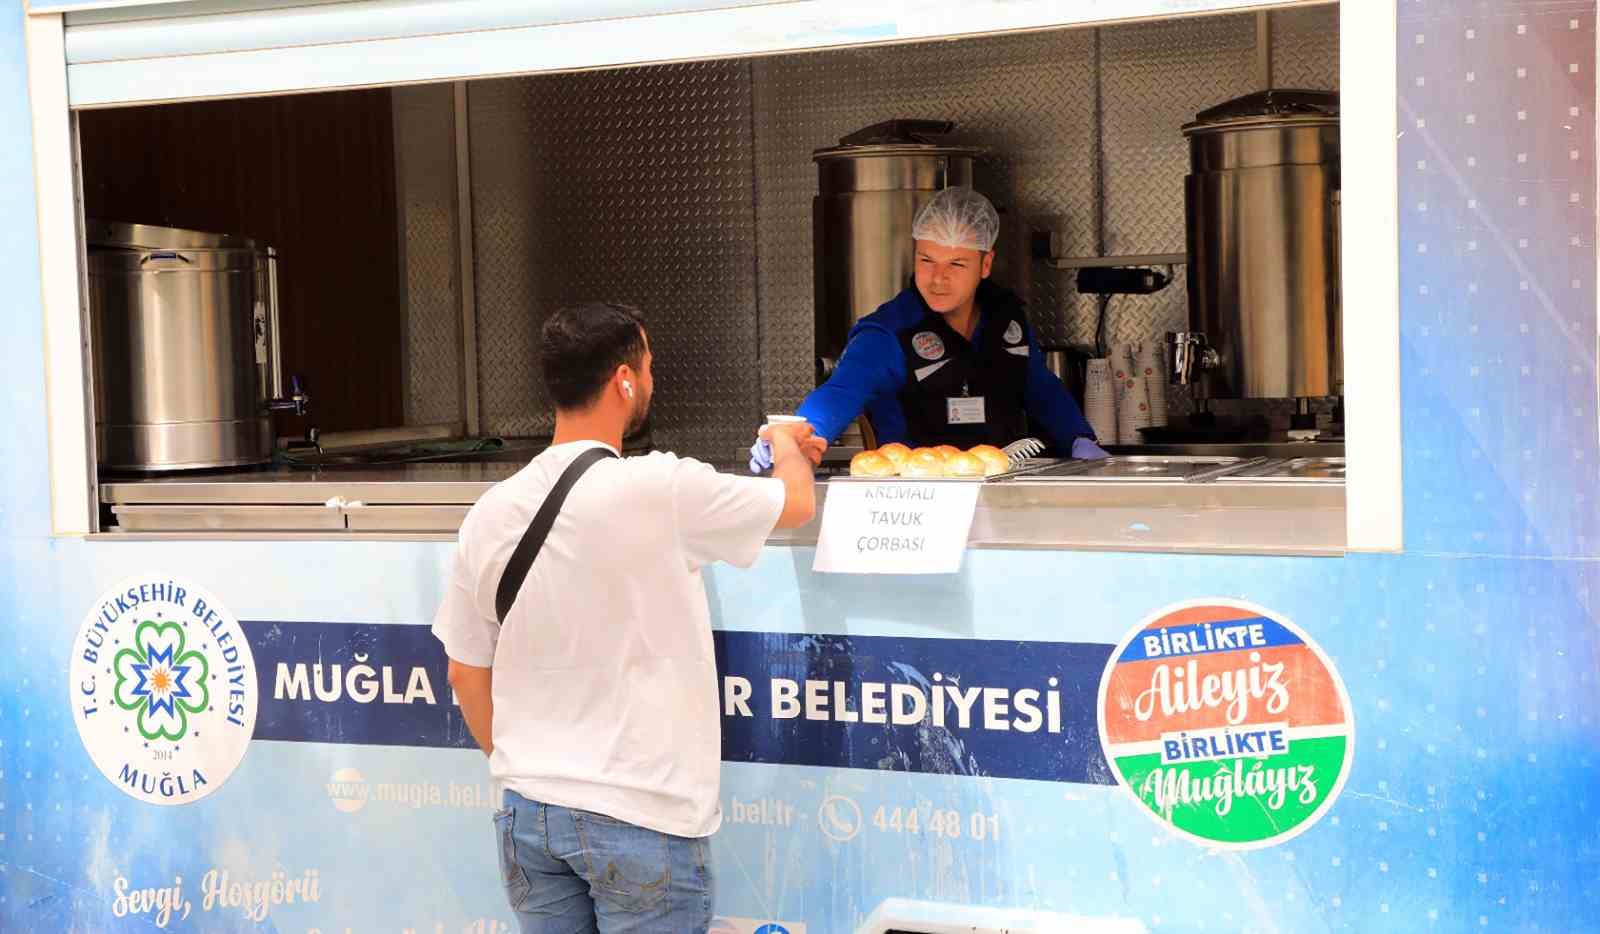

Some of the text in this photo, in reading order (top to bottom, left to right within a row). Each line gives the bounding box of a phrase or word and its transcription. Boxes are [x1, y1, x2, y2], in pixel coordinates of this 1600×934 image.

[869, 510, 925, 526] TAVUK
[856, 535, 926, 553] ÇORBASI
[81, 580, 246, 727] T.C. BÜYÜKŞEHİR BELEDİYESİ
[1143, 623, 1267, 657] BİRLİKTE
[274, 652, 437, 705] MUĞLA
[1134, 652, 1291, 725] Aileyiz
[770, 672, 1062, 733] BELEDİYESİ
[152, 750, 173, 761] 2014
[1163, 729, 1286, 760] BİRLİKTE
[118, 764, 208, 797] MUĞLA
[872, 804, 921, 834] 444
[928, 809, 961, 839] 48
[970, 811, 1001, 841] 01
[111, 868, 321, 928] Sevgi, Hoşgörü
